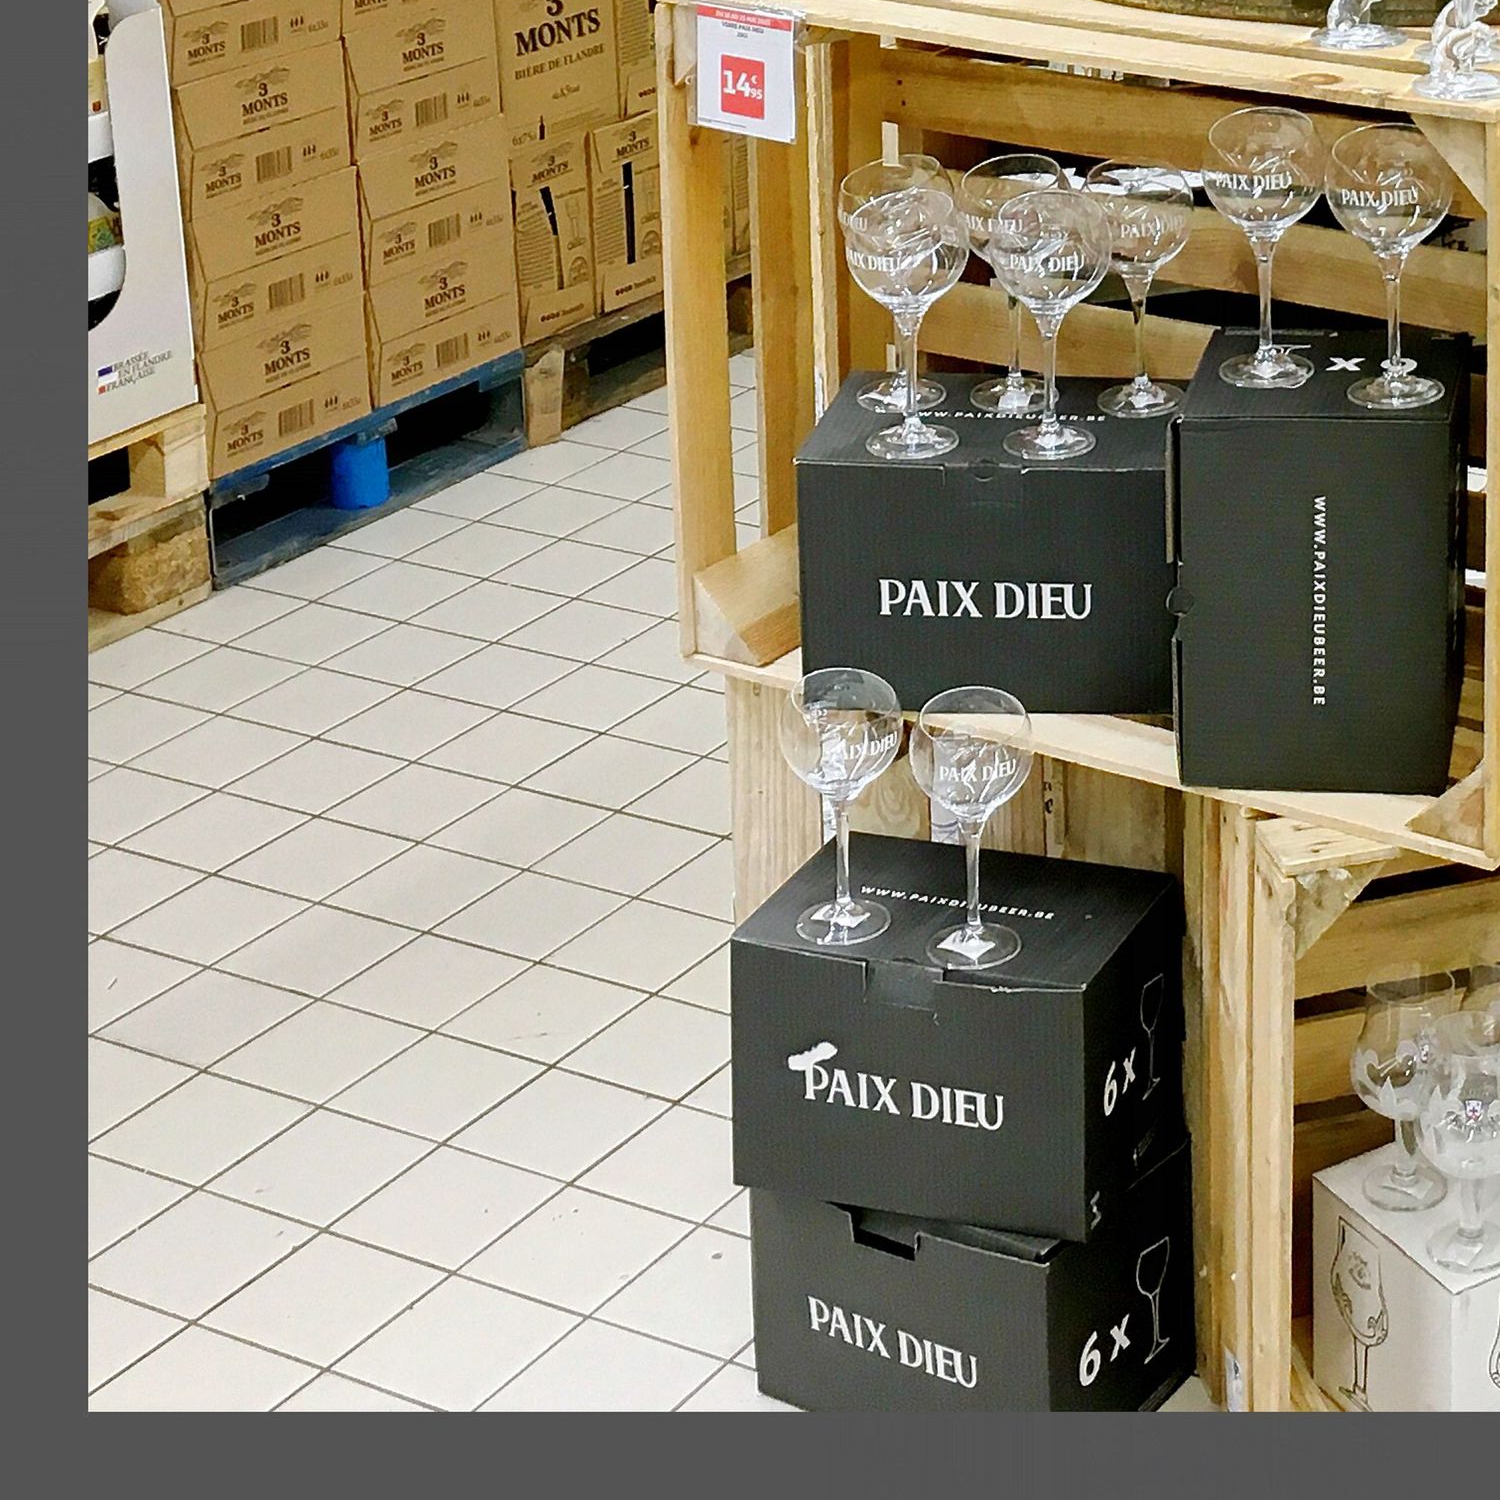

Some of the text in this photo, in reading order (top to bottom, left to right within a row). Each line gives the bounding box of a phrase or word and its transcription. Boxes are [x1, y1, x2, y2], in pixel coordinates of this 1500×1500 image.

[514, 8, 601, 57] MONTS
[514, 43, 605, 81] BIÈRE DE FLANDRE
[1214, 171, 1292, 191] PAIX DIEU
[1341, 185, 1419, 206] PAIX DIEU
[1049, 255, 1085, 272] DIEU
[878, 578, 1094, 620] PAIX DIEU
[1313, 494, 1327, 705] WWW.PAIXDIEUBEER.BE
[861, 883, 1055, 921] WWW.PAIXDIUBEER.BE
[804, 1062, 1004, 1132] PAIX DIEU
[1102, 1047, 1139, 1117] 6x
[807, 1294, 978, 1390] PAIX DIEU
[1077, 1312, 1131, 1388] 6x
